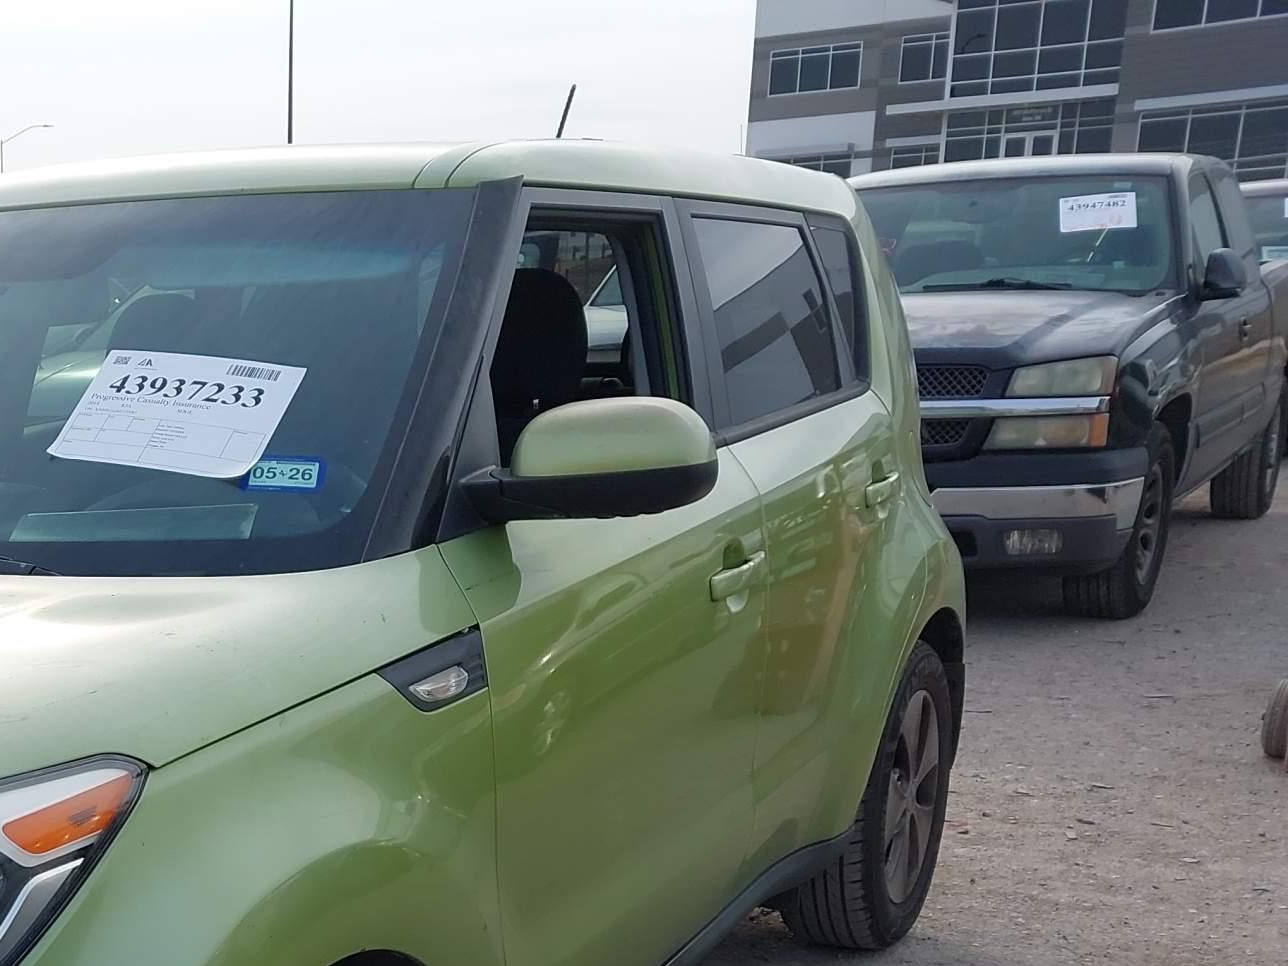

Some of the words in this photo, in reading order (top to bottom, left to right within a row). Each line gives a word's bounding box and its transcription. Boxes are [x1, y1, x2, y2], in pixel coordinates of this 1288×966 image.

[109, 374, 265, 408] 43937233
[253, 466, 277, 479] 05
[288, 468, 313, 481] 26
